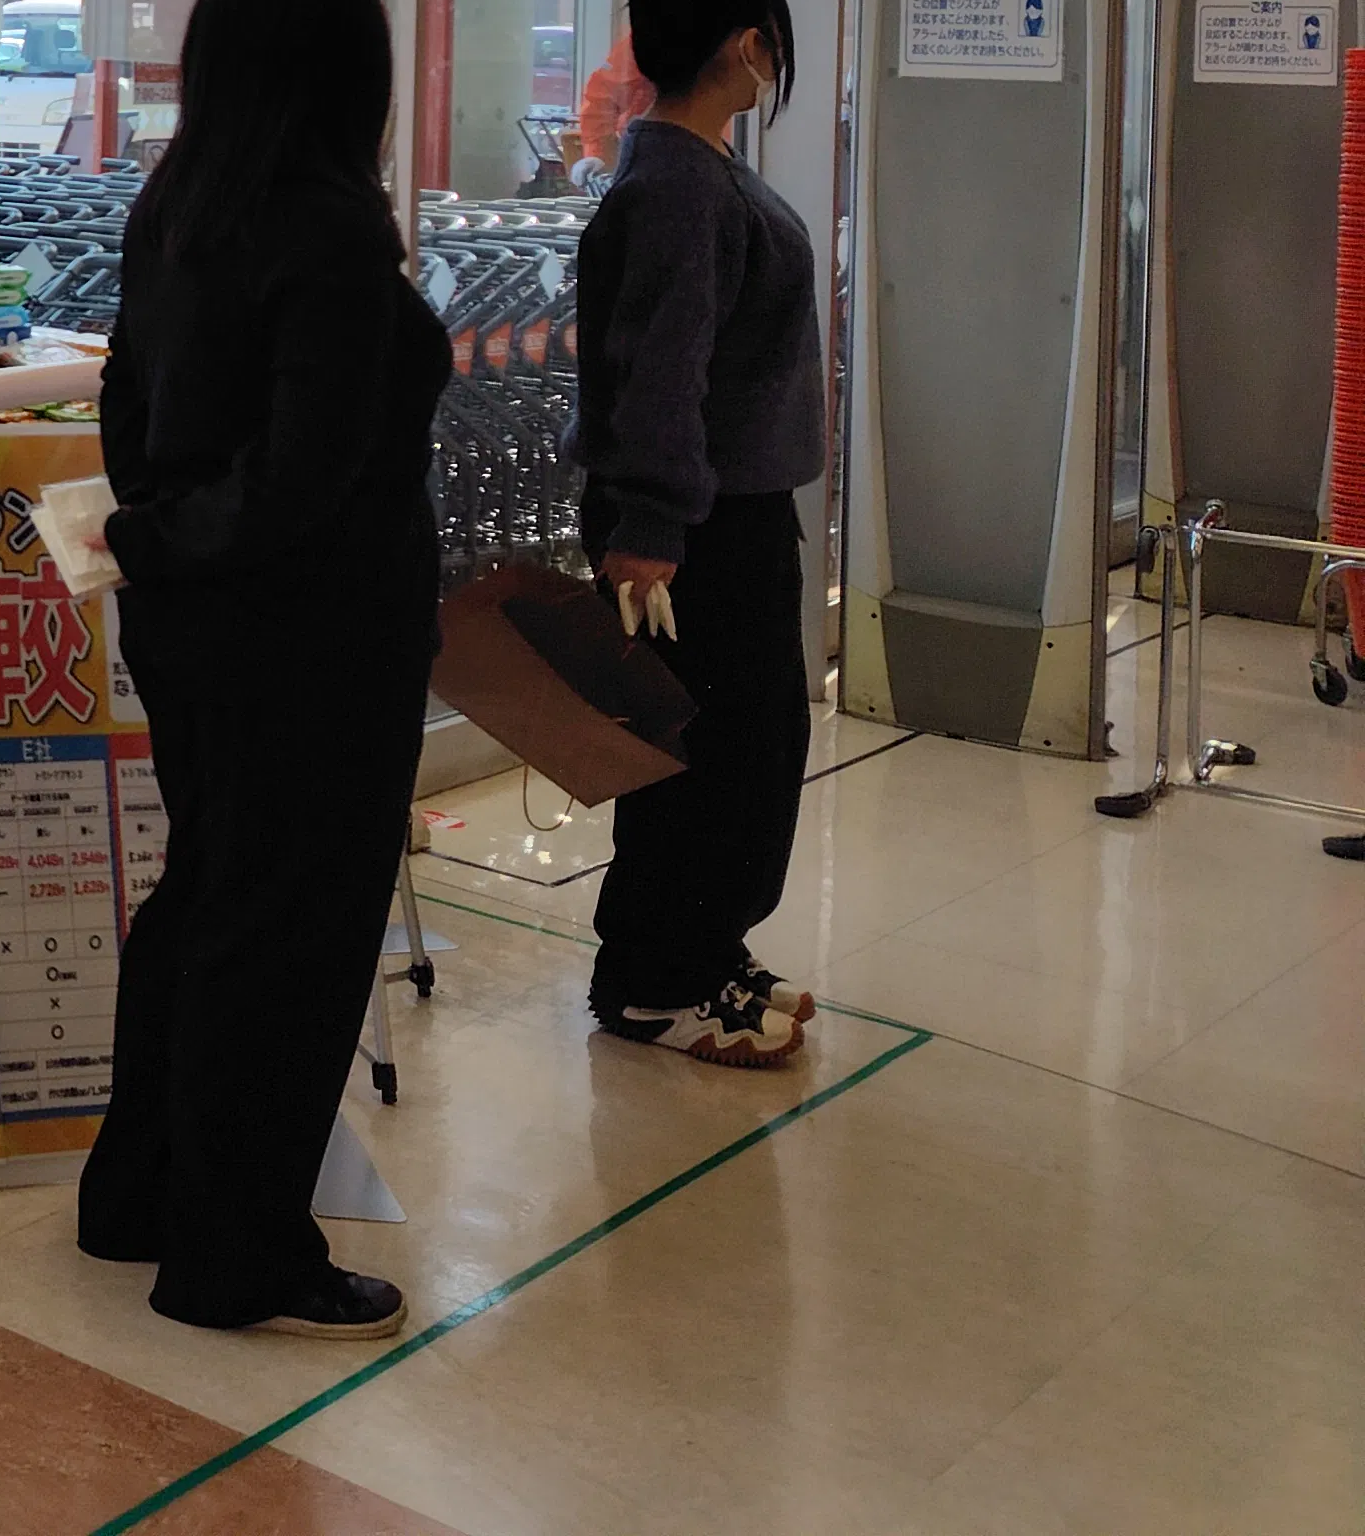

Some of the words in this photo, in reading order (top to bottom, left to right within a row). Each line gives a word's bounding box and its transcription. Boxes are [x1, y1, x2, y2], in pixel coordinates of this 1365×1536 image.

[1250, 1, 1283, 14] ご案内
[23, 740, 53, 761] E社
